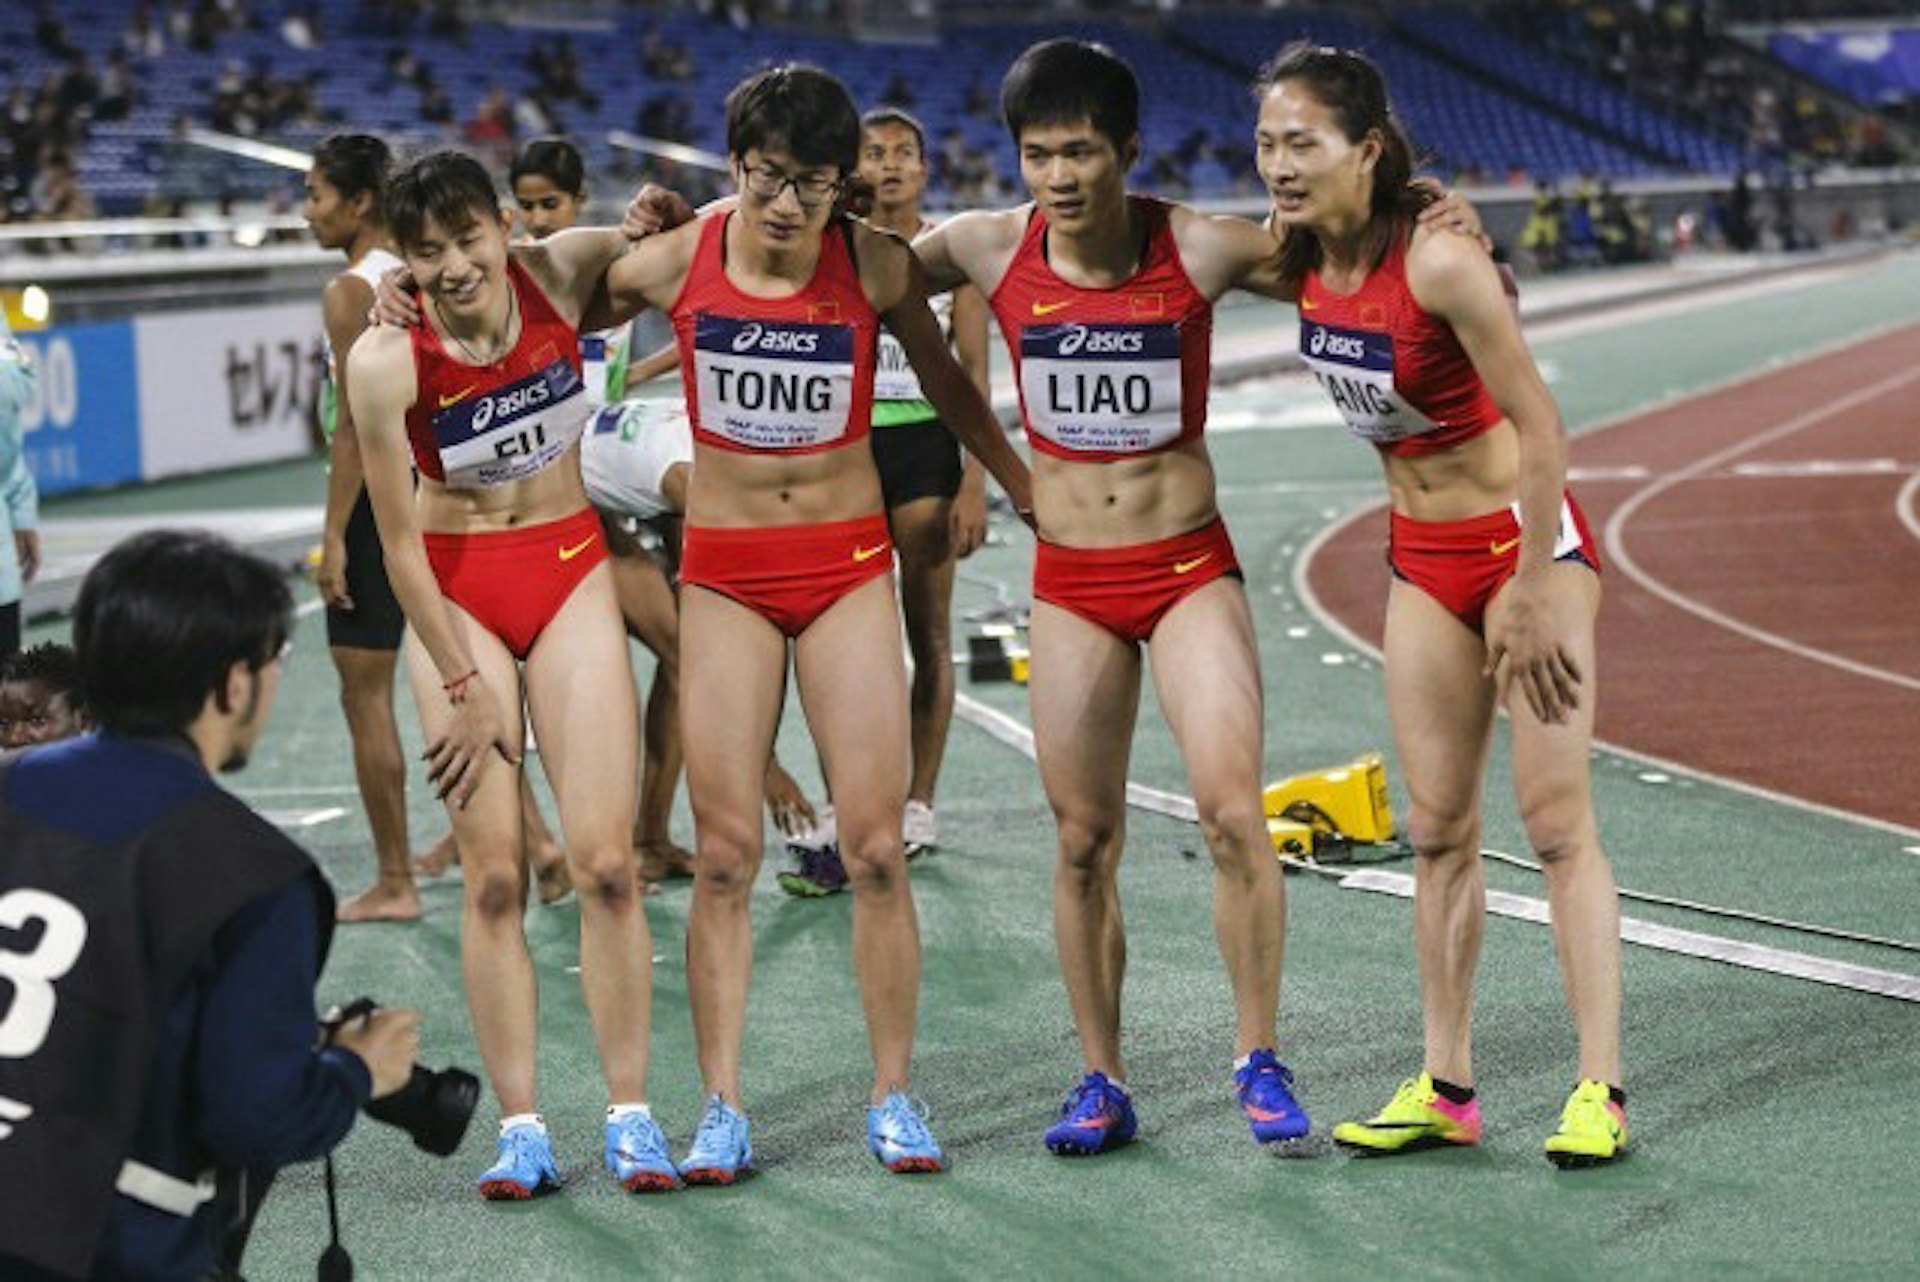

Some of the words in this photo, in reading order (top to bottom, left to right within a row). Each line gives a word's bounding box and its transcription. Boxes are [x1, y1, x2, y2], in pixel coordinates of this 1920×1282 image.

[759, 330, 819, 353] asics
[1086, 330, 1144, 353] asics
[709, 365, 833, 413] TONG
[1048, 374, 1151, 414] LIAO
